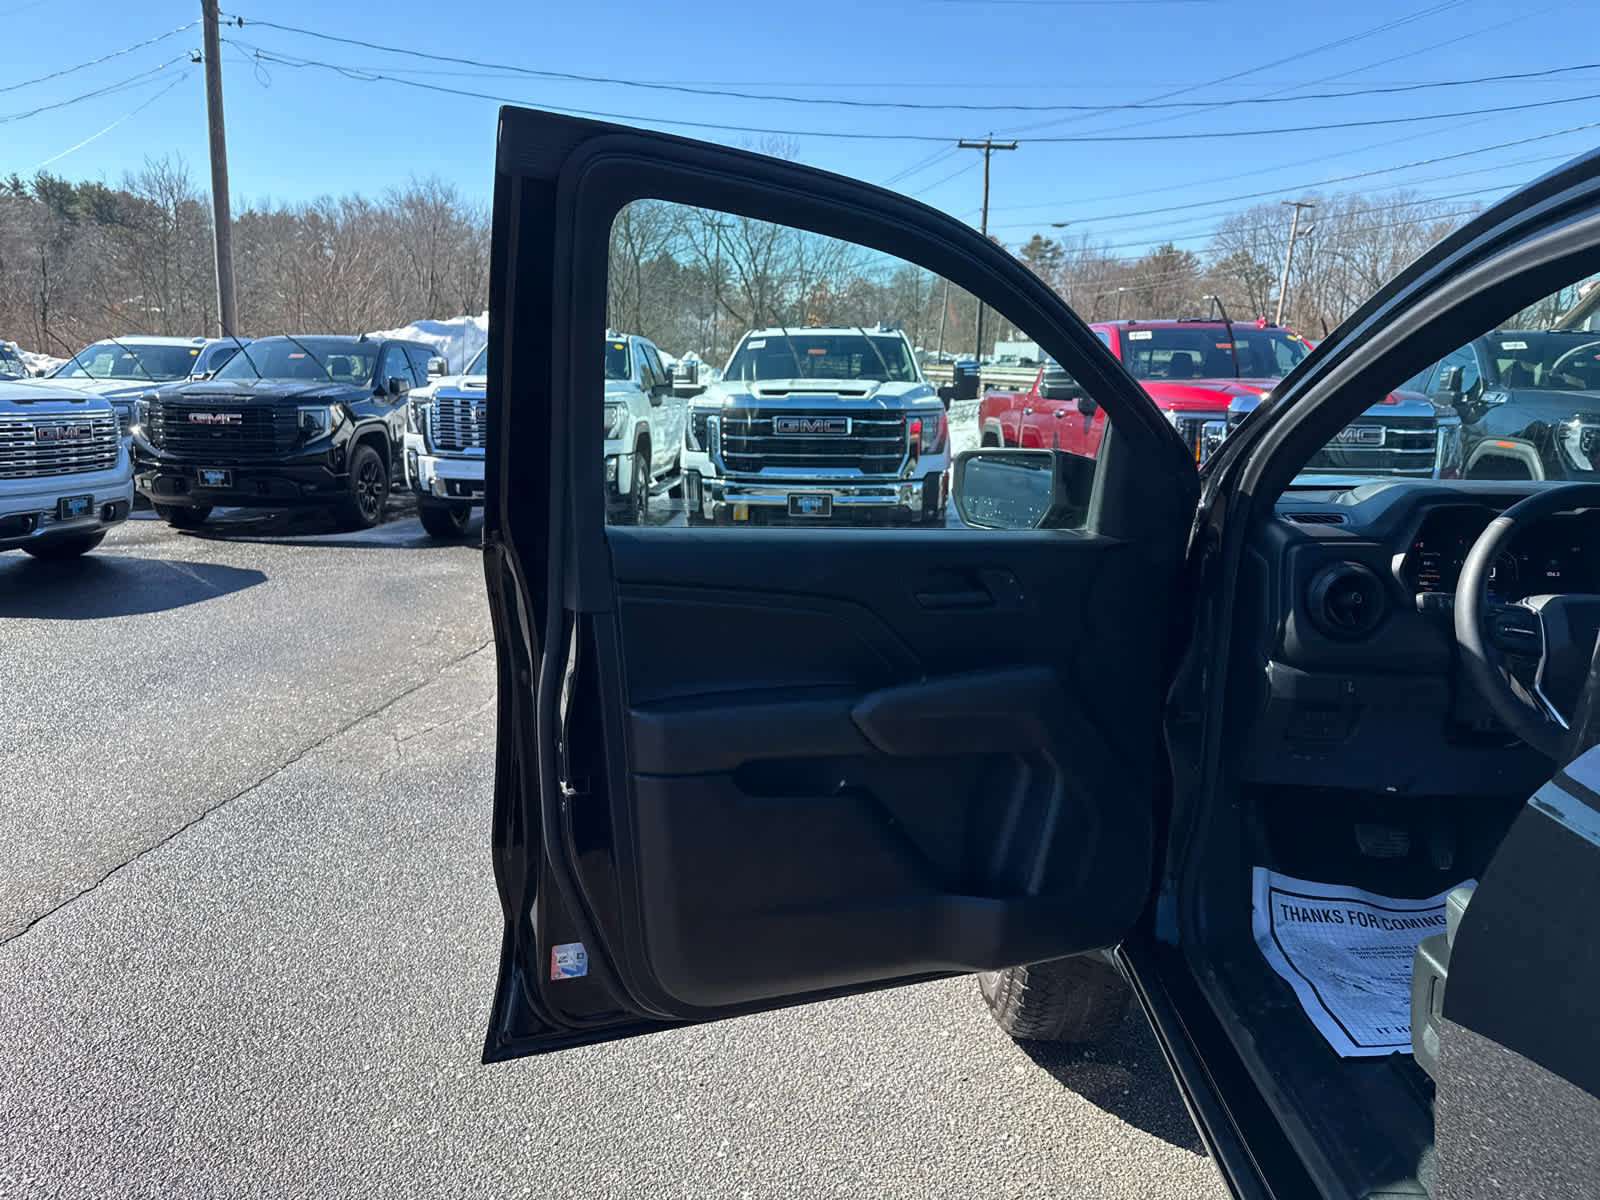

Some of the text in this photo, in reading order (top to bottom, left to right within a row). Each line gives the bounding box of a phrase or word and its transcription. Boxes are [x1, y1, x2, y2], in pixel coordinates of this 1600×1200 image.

[189, 412, 242, 424] GMC
[778, 419, 846, 433] GMC
[38, 425, 90, 441] GMC
[1330, 427, 1382, 443] MC
[1280, 903, 1447, 931] THANKS FOR COMING
